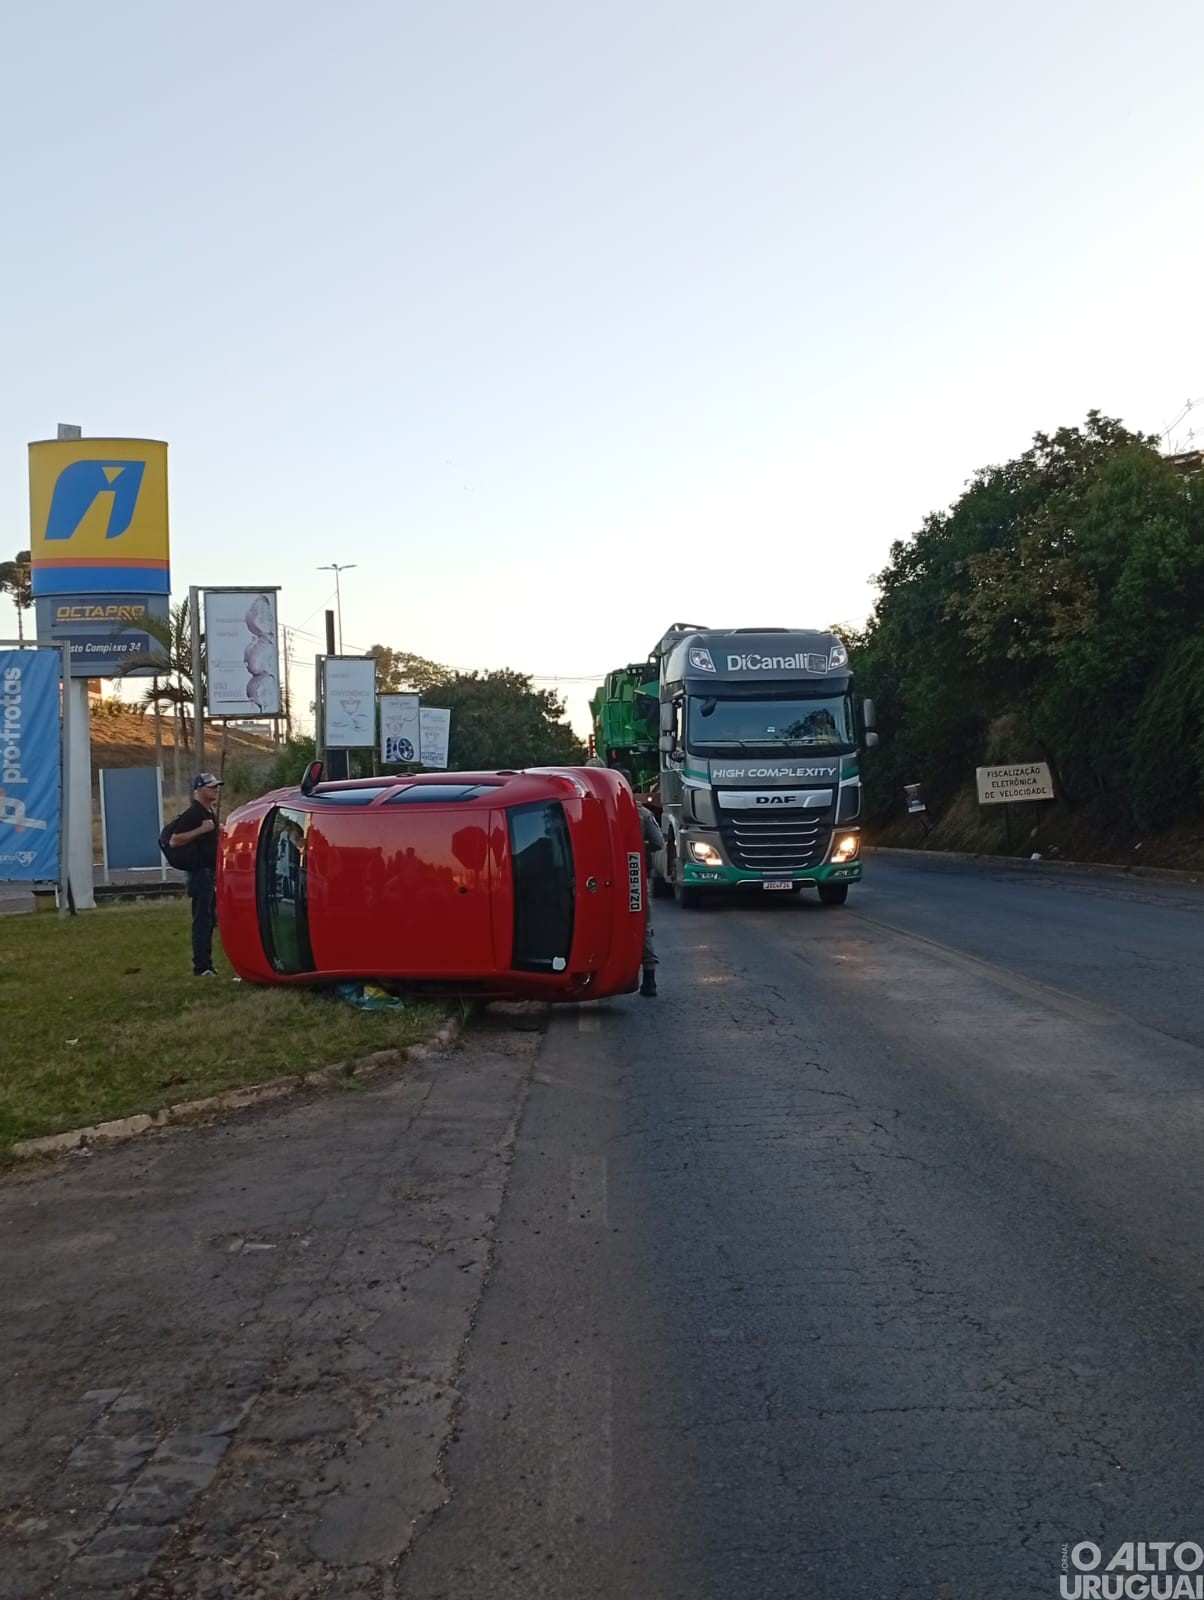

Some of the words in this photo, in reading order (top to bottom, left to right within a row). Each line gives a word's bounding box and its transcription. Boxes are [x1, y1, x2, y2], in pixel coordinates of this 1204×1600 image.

[70, 643, 83, 653] sto
[129, 642, 142, 651] 34
[727, 653, 808, 671] DiCanalli
[713, 768, 745, 778] HIGH
[748, 767, 837, 778] COMPLEXITY
[986, 766, 1041, 778] FISCALIZAÇÃO
[991, 778, 1037, 788] ELETRÔNICA
[984, 791, 996, 799] DE
[1000, 787, 1047, 798] VELOCIDADE
[756, 796, 797, 805] DAF
